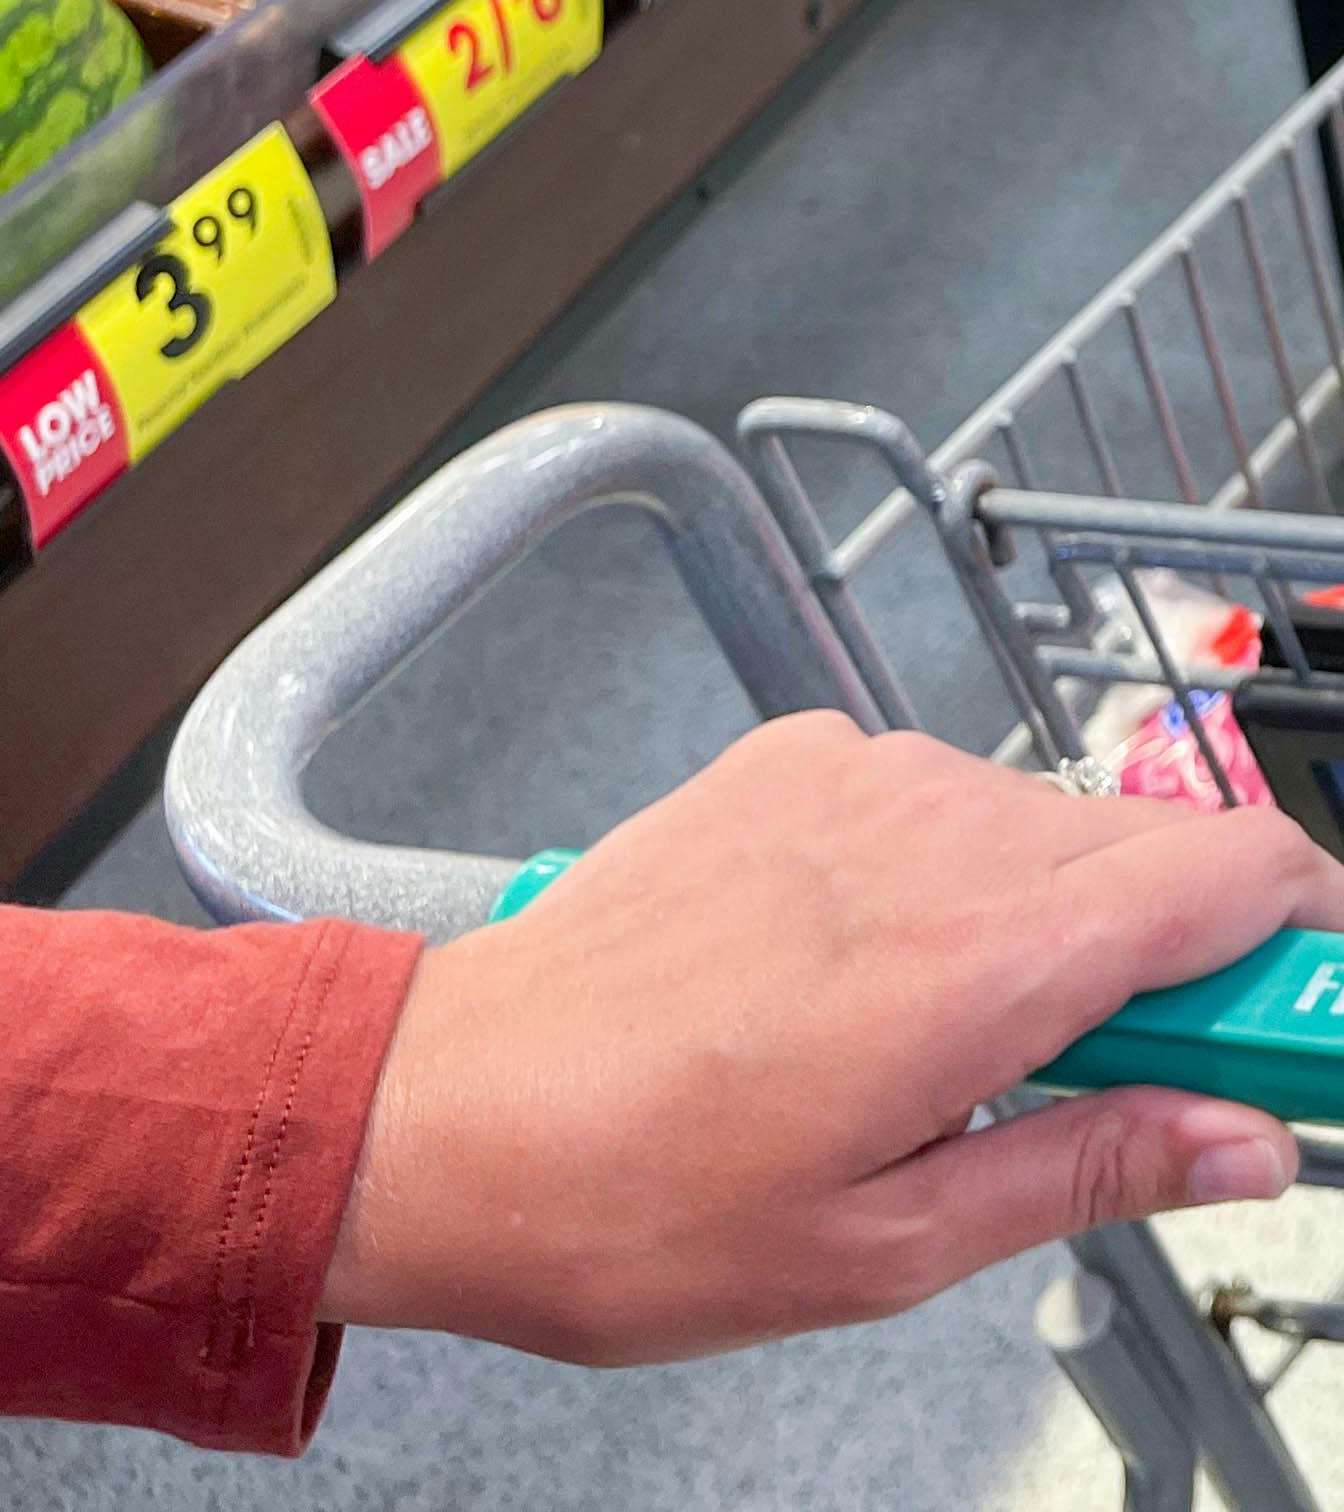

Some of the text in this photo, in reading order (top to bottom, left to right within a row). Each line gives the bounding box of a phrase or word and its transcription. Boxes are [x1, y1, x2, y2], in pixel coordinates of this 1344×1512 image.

[360, 105, 433, 190] SALE
[18, 368, 101, 465] LOW
[35, 402, 116, 496] PRICE
